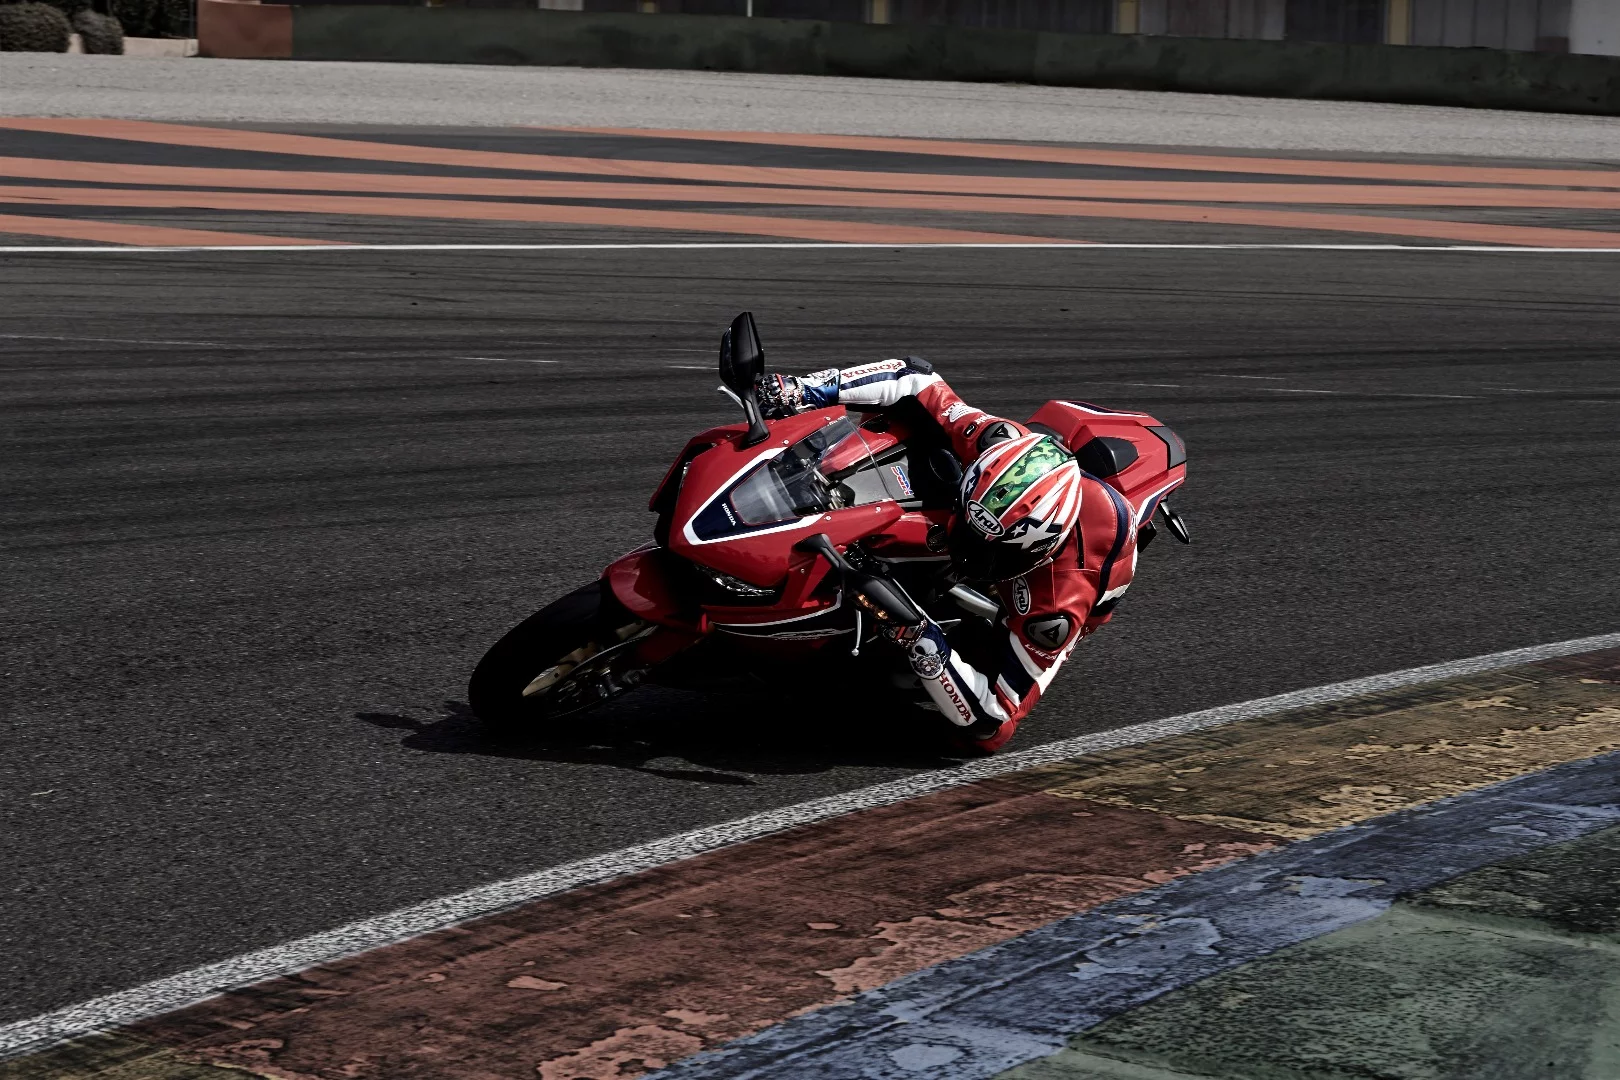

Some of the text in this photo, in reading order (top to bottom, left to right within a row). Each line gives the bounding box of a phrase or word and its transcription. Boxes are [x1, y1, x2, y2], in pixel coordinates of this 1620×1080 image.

[842, 361, 904, 379] HONDA
[721, 502, 737, 527] HONDA
[968, 505, 1000, 533] Arai
[1015, 579, 1029, 609] Arai
[938, 672, 972, 723] HONDA
